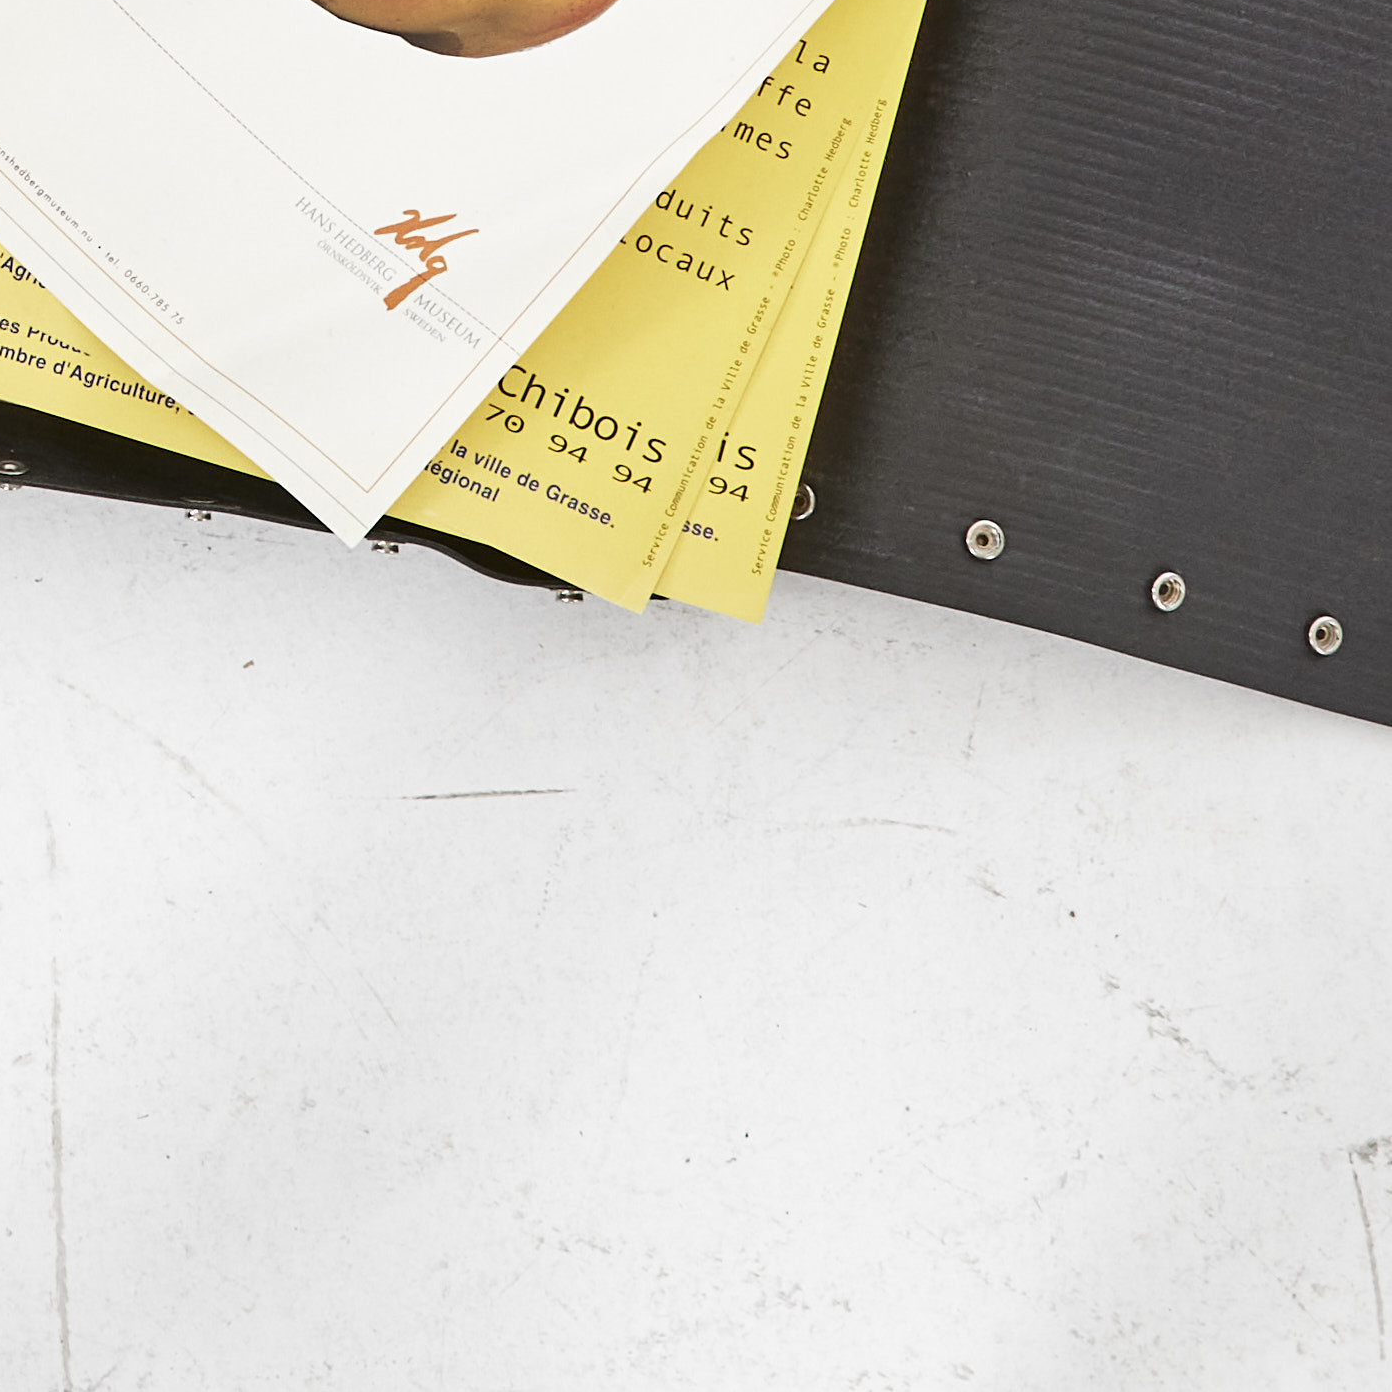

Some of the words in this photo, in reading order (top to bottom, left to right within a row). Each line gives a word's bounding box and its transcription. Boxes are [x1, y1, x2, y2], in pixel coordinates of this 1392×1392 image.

[793, 38, 831, 74] la
[864, 99, 888, 145] Hedberg
[848, 151, 872, 208] Charlotte
[294, 196, 336, 234] HANS
[333, 229, 397, 282] HEDBERG
[412, 293, 481, 350] MUSEUM
[402, 307, 447, 343] SWEDEN
[816, 288, 835, 329] Grasse
[641, 522, 669, 567] Service
[705, 416, 716, 430] de
[712, 396, 725, 409] la
[720, 359, 742, 391] Ville
[739, 340, 751, 354] de
[746, 296, 770, 335] Grasse
[797, 166, 829, 222] Charlotte
[823, 117, 852, 162] Hedberg
[812, 334, 823, 349] de
[51, 359, 181, 415] d'Agriculture,
[800, 355, 817, 388] Ville
[497, 364, 668, 465] Chibois
[790, 415, 802, 429] de
[795, 395, 807, 407] la
[449, 438, 468, 459] la
[473, 451, 512, 479] ville
[516, 471, 540, 492] de
[544, 484, 616, 528] Grasse.
[547, 434, 588, 465] 94
[612, 463, 653, 495] 94
[708, 475, 751, 503] 94
[750, 528, 772, 575] Service
